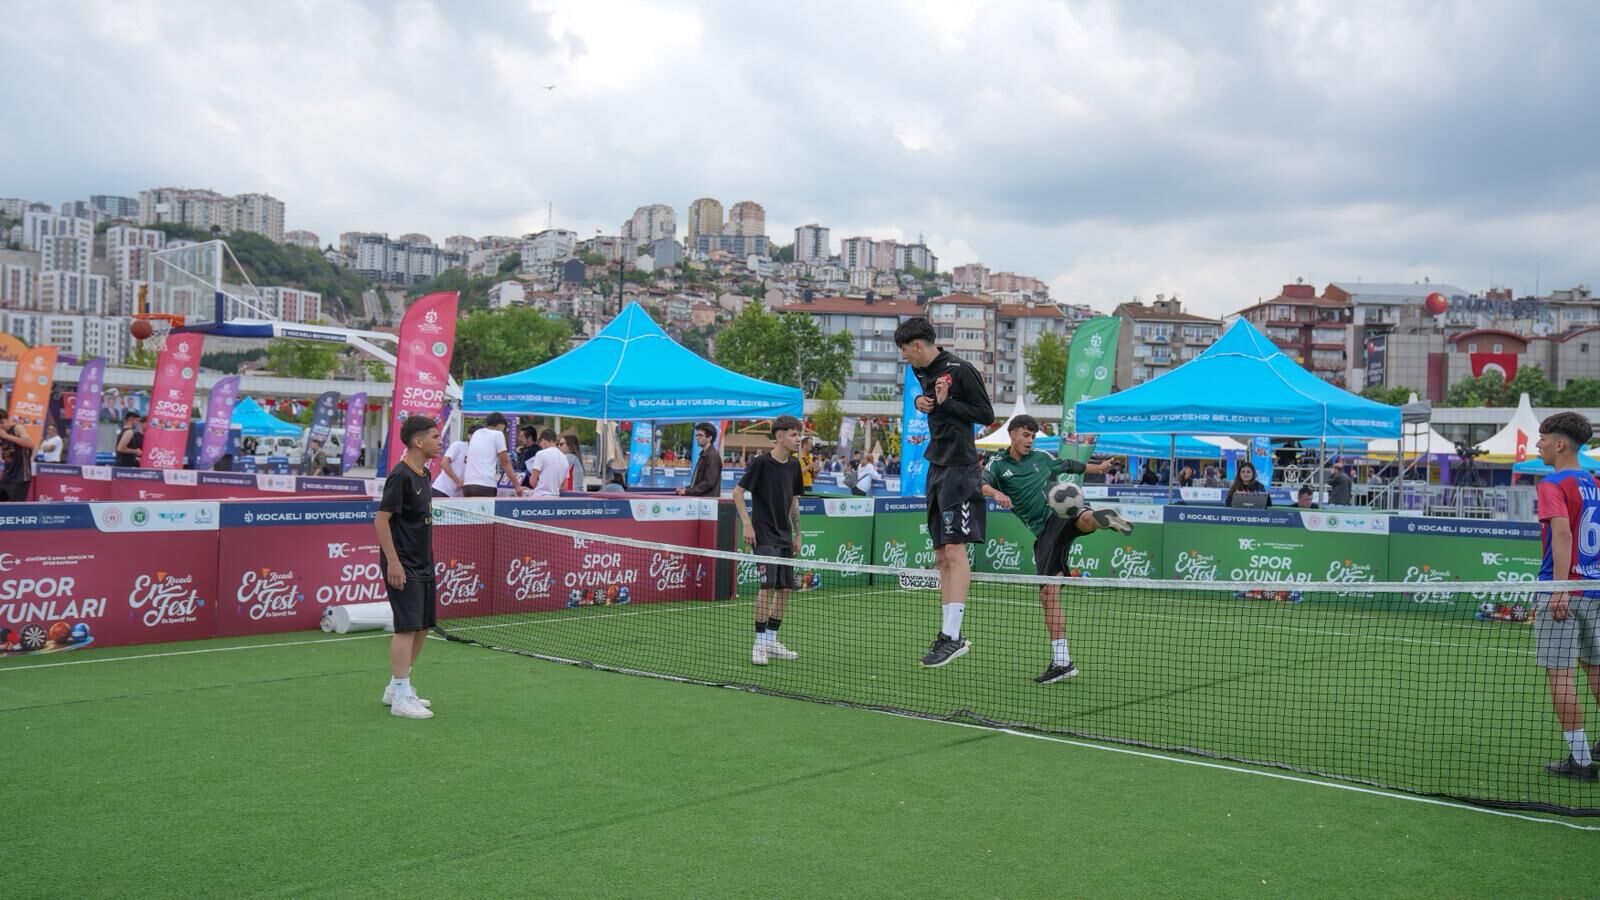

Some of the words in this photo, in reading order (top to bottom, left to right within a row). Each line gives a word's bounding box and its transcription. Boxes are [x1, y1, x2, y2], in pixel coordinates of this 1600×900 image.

[403, 386, 444, 401] SPOR
[155, 400, 188, 414] SPOR
[402, 399, 442, 409] OYUNLARI
[257, 512, 302, 521] KOCAELİ
[305, 511, 367, 520] BÜYÜKŞEHİR
[521, 508, 555, 516] KOCAELİ
[556, 508, 604, 516] BÜYÜKŞEHİR
[1221, 515, 1270, 523] BÜYÜKŞEHİR
[1417, 524, 1458, 533] KOCAELİ
[1460, 527, 1520, 536] BÜYÜKŞEHİR
[1577, 506, 1600, 557] 6
[582, 552, 621, 569] SPOR
[993, 552, 1021, 570] Fest
[1249, 554, 1292, 570] SPOR
[564, 568, 638, 588] OYUNLARI
[1231, 568, 1312, 583] OYUNLARI
[0, 576, 75, 600] SPOR
[440, 574, 480, 606] Fest
[515, 570, 553, 601] Fest
[143, 589, 199, 627] Fest
[249, 584, 300, 621] Fest
